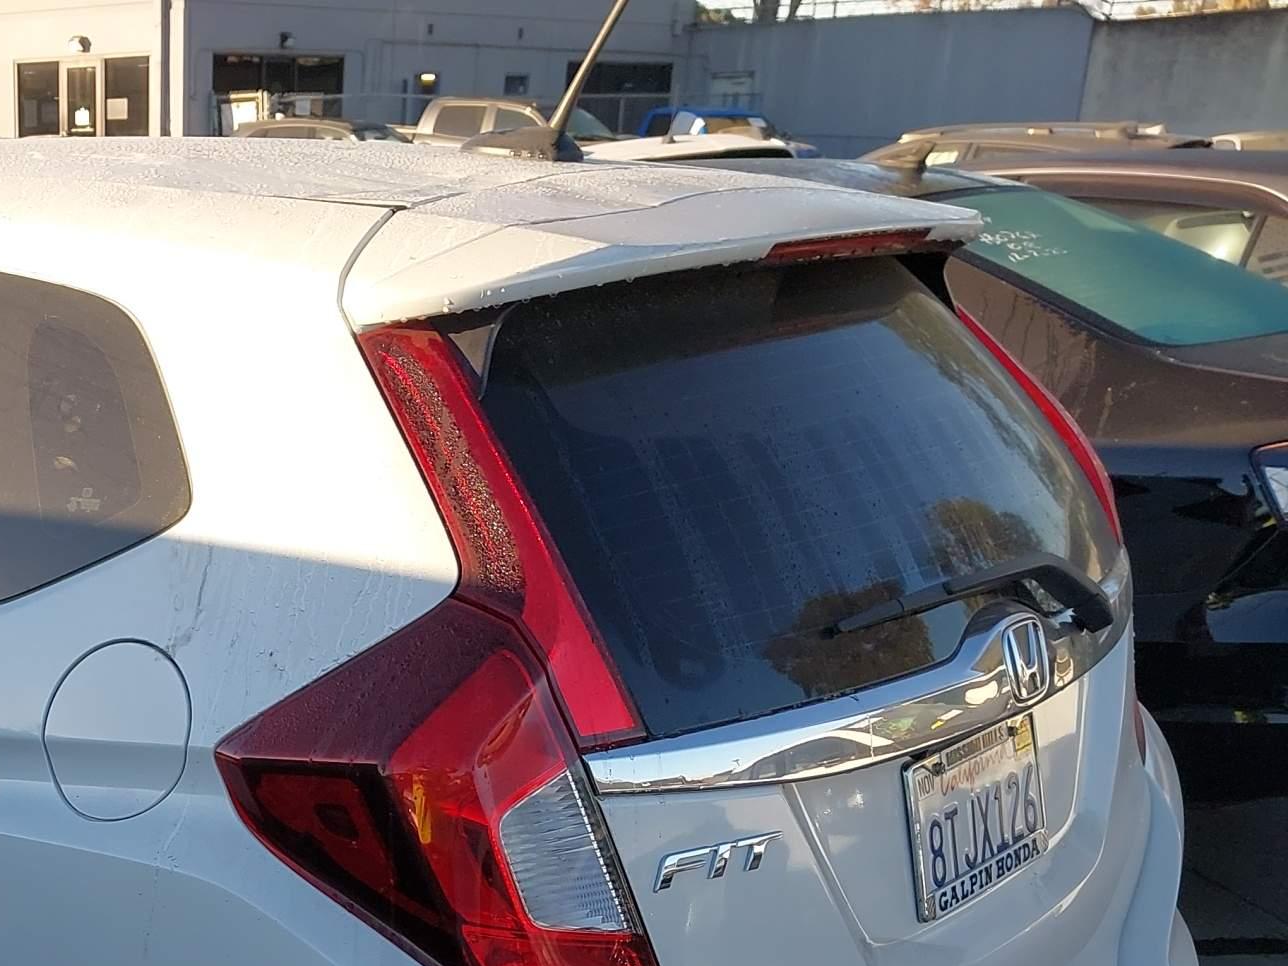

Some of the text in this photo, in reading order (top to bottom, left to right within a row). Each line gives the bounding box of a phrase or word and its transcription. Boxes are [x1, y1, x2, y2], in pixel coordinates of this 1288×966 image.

[917, 773, 935, 798] NOV
[940, 745, 1013, 796] California
[928, 762, 1039, 888] 8TJX126
[653, 831, 784, 893] FIT
[938, 838, 1041, 912] GALPIN HONDA
